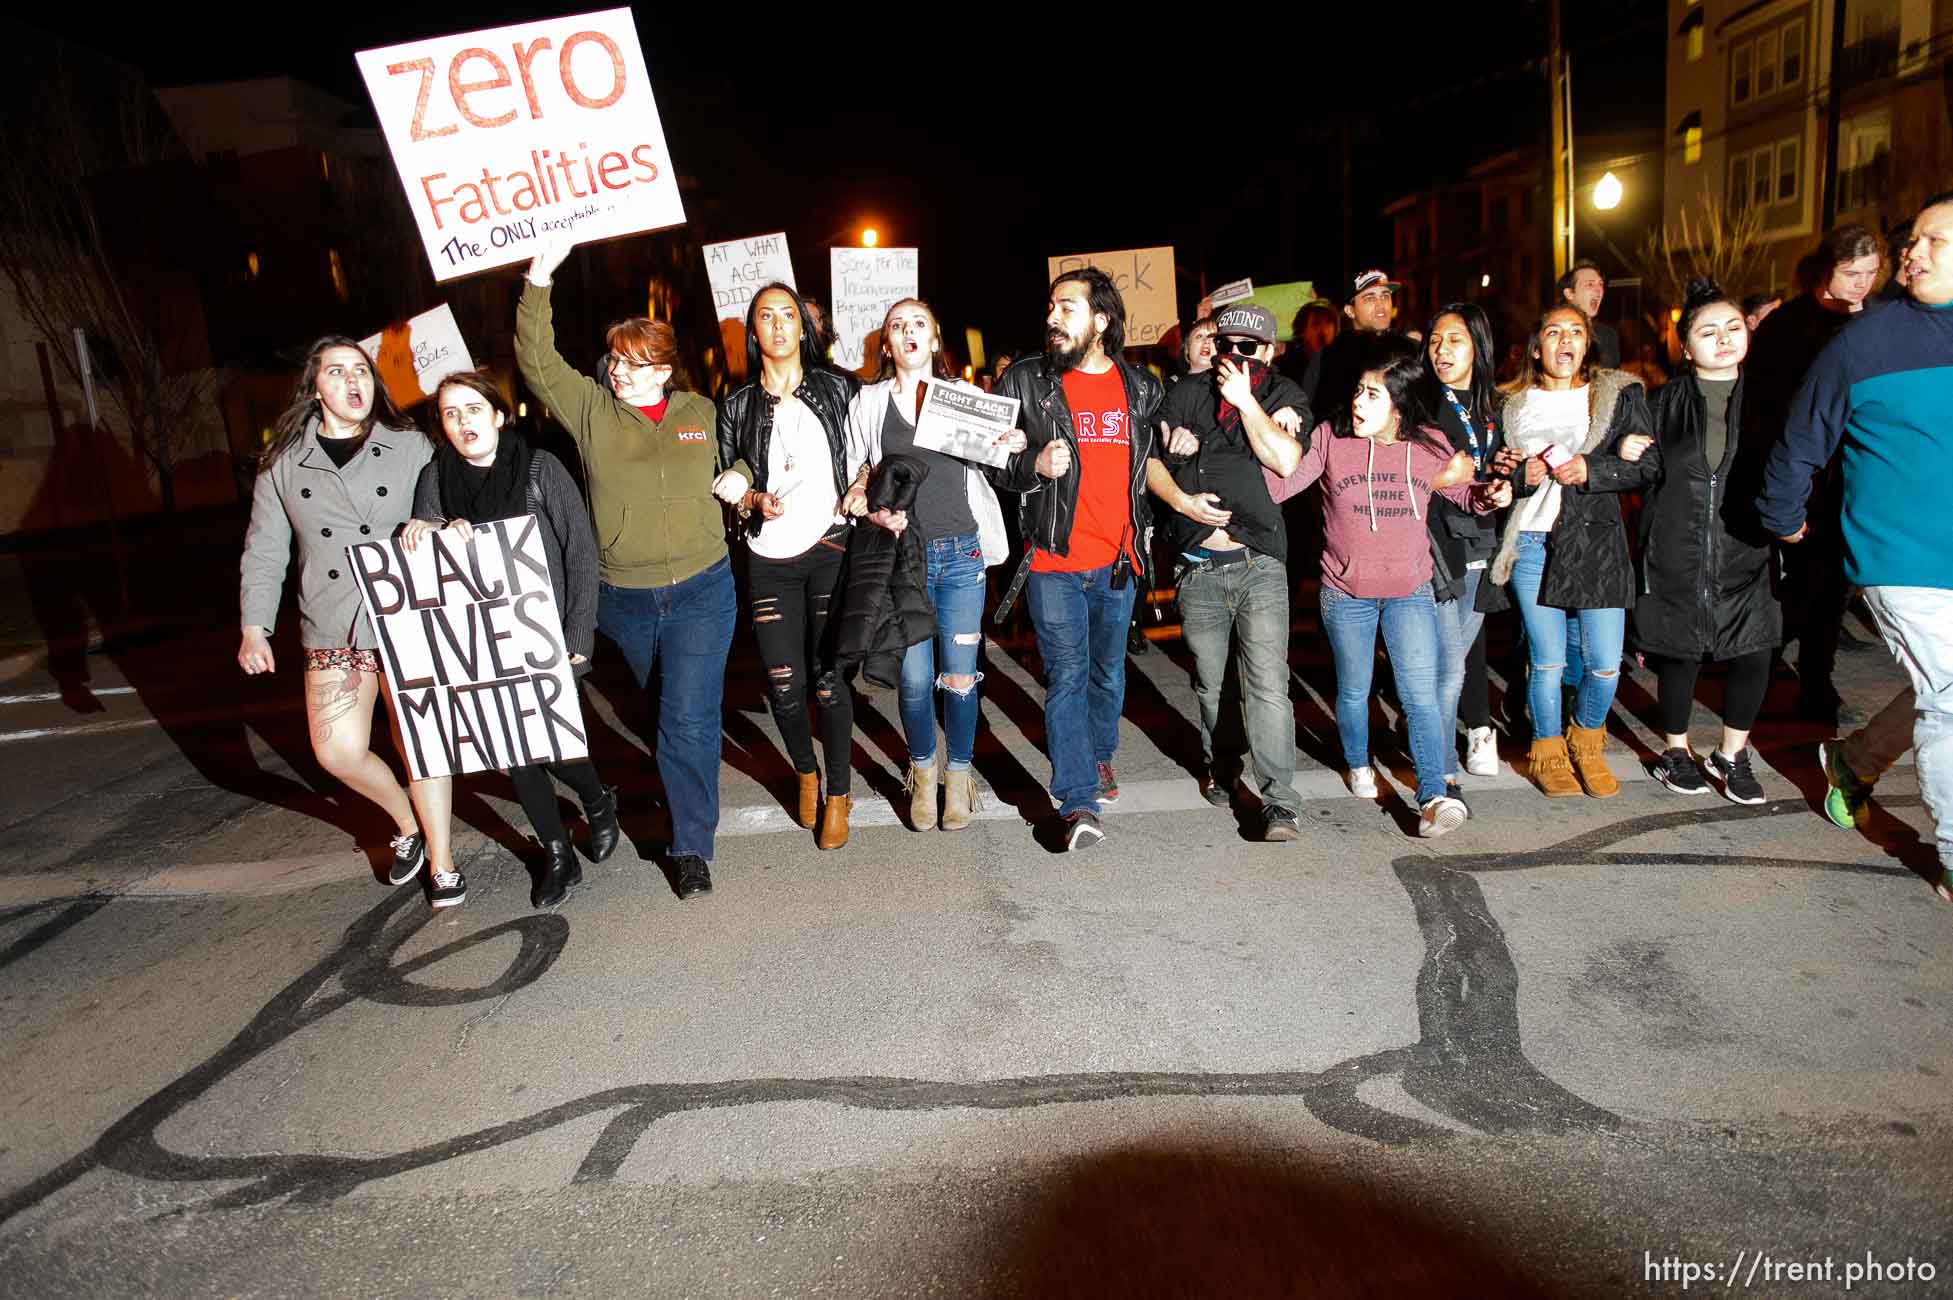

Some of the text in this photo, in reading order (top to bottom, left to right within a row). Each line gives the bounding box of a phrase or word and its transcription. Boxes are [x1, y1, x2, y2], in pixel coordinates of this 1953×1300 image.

[420, 142, 659, 230] Fatalities
[440, 235, 488, 266] The
[490, 216, 537, 249] ONLY
[710, 237, 780, 265] AT WHAT
[714, 286, 753, 308] DID
[730, 261, 768, 284] AGE
[938, 388, 974, 406] FIGHT
[975, 400, 1010, 417] BACK!
[352, 514, 551, 617] BLACK
[376, 590, 563, 691] LIVES
[398, 672, 587, 779] MATTER
